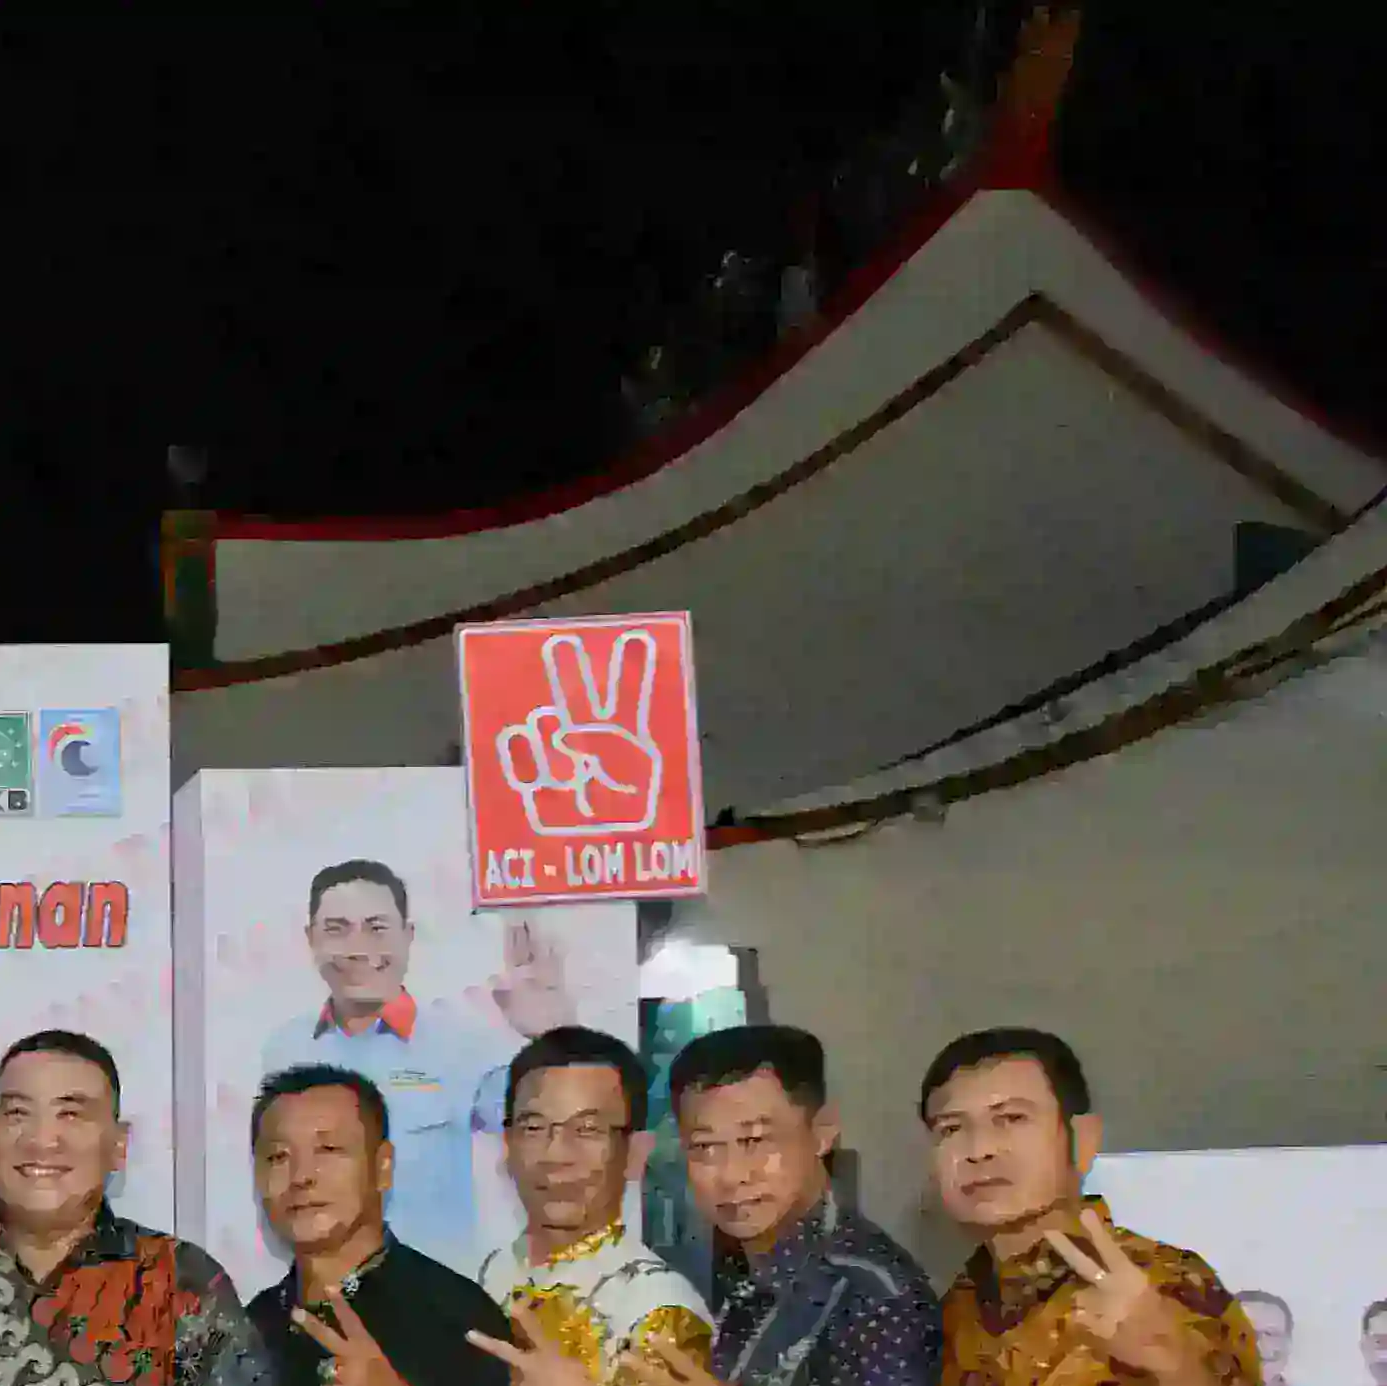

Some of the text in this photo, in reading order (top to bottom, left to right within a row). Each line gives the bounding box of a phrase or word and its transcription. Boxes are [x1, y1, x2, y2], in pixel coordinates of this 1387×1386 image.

[486, 848, 536, 890] ACI
[565, 842, 625, 887] LOM
[633, 839, 695, 882] LOM
